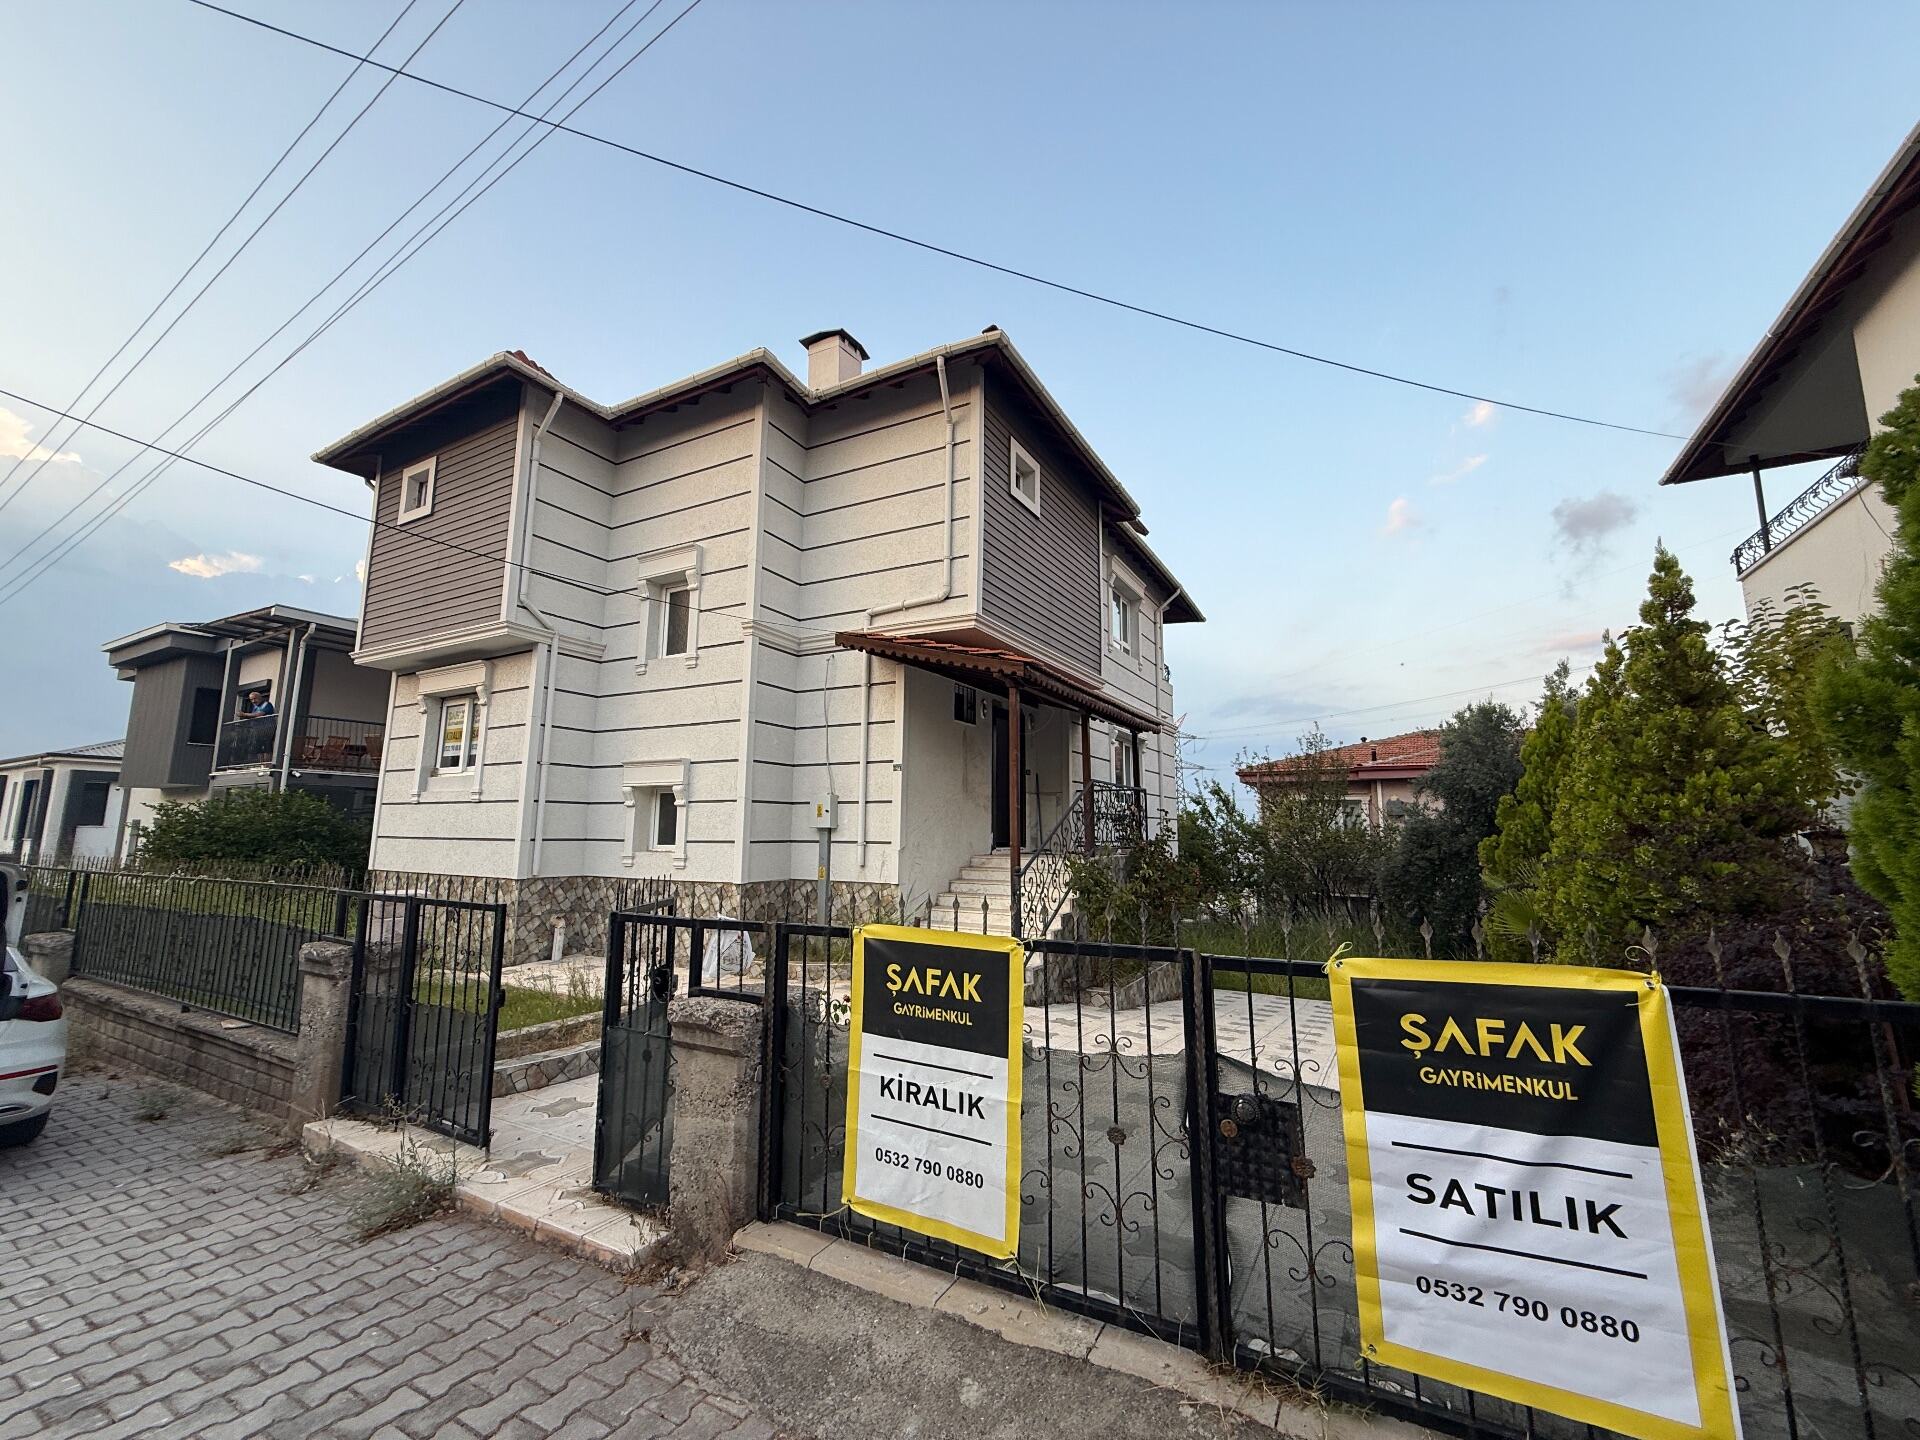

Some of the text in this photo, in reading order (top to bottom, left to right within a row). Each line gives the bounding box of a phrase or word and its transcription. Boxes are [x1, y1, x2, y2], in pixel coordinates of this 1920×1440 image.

[886, 963, 982, 1003] ŞAFAK
[893, 1001, 973, 1026] GAYRİMENKUL
[1400, 1013, 1592, 1067] ŞAFAK
[880, 1073, 986, 1120] KİRALIK
[1419, 1066, 1578, 1101] GAYRİMENKUL
[875, 1147, 984, 1189] 0532 790 0880
[1406, 1172, 1629, 1240] SATILIK
[1415, 1275, 1640, 1343] 0532 790 0880
